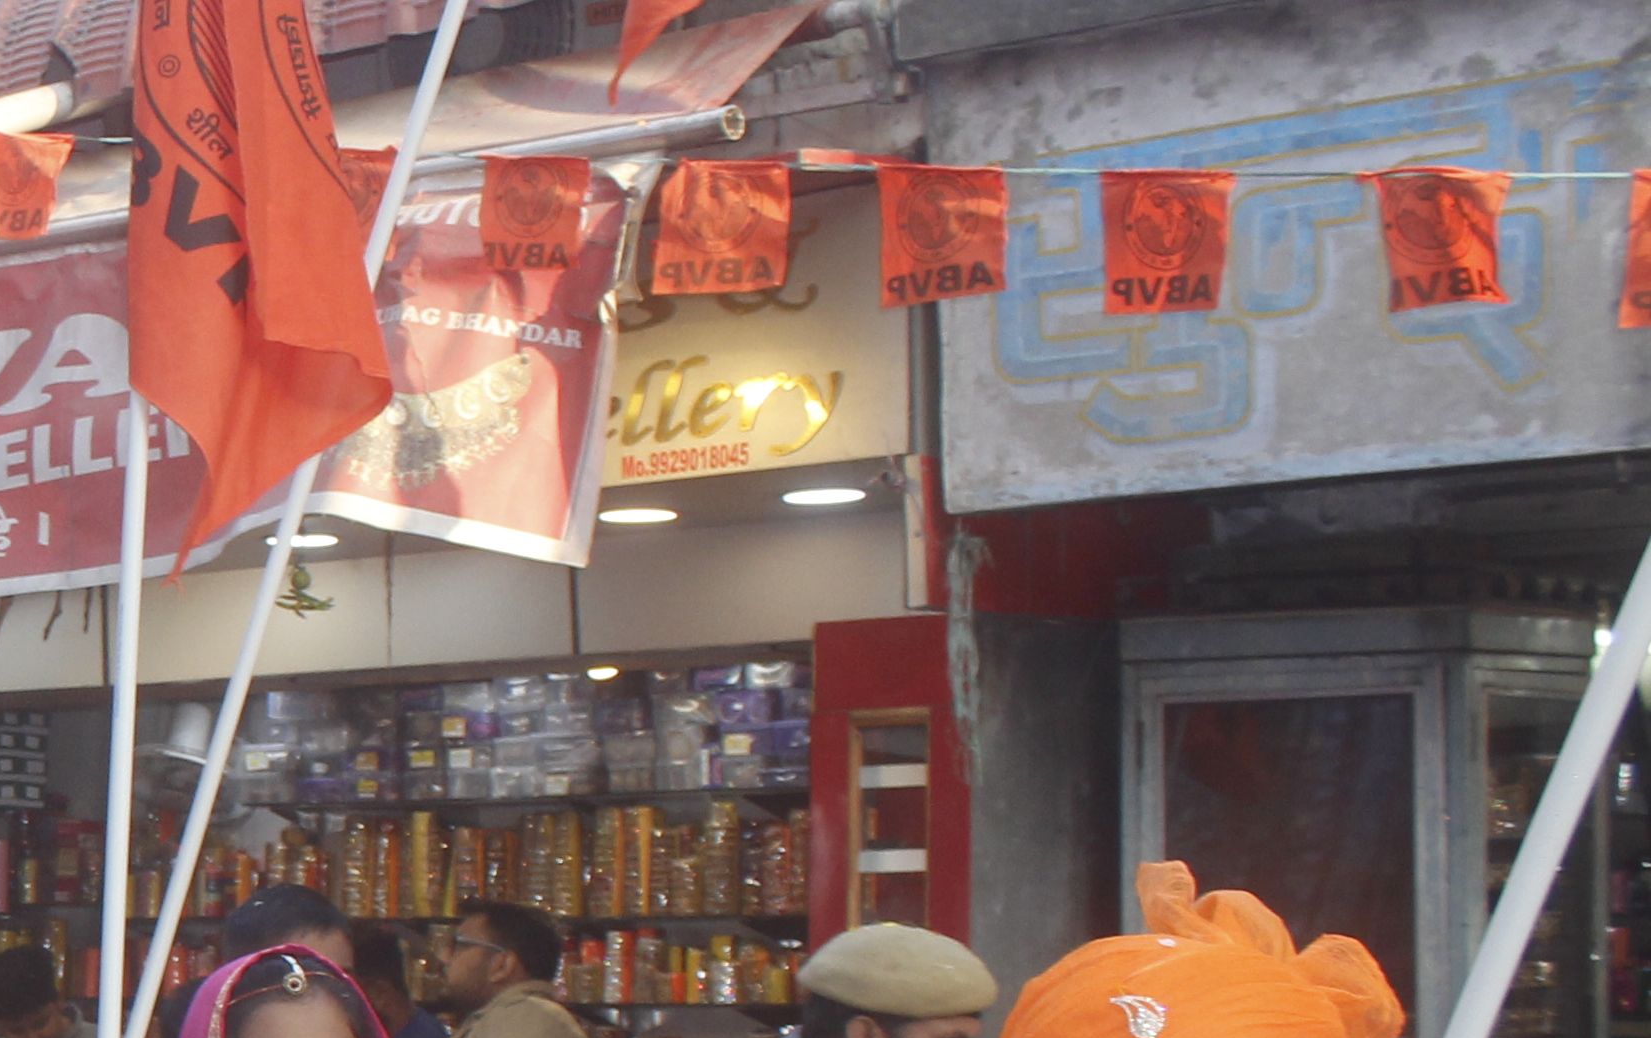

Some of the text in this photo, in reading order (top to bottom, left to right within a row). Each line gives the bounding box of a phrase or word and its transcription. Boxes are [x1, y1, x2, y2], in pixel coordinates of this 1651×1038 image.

[185, 106, 235, 161] शील
[445, 309, 584, 350] BHANDAR
[605, 352, 847, 458] ellery
[621, 442, 751, 480] Mo.9929018045
